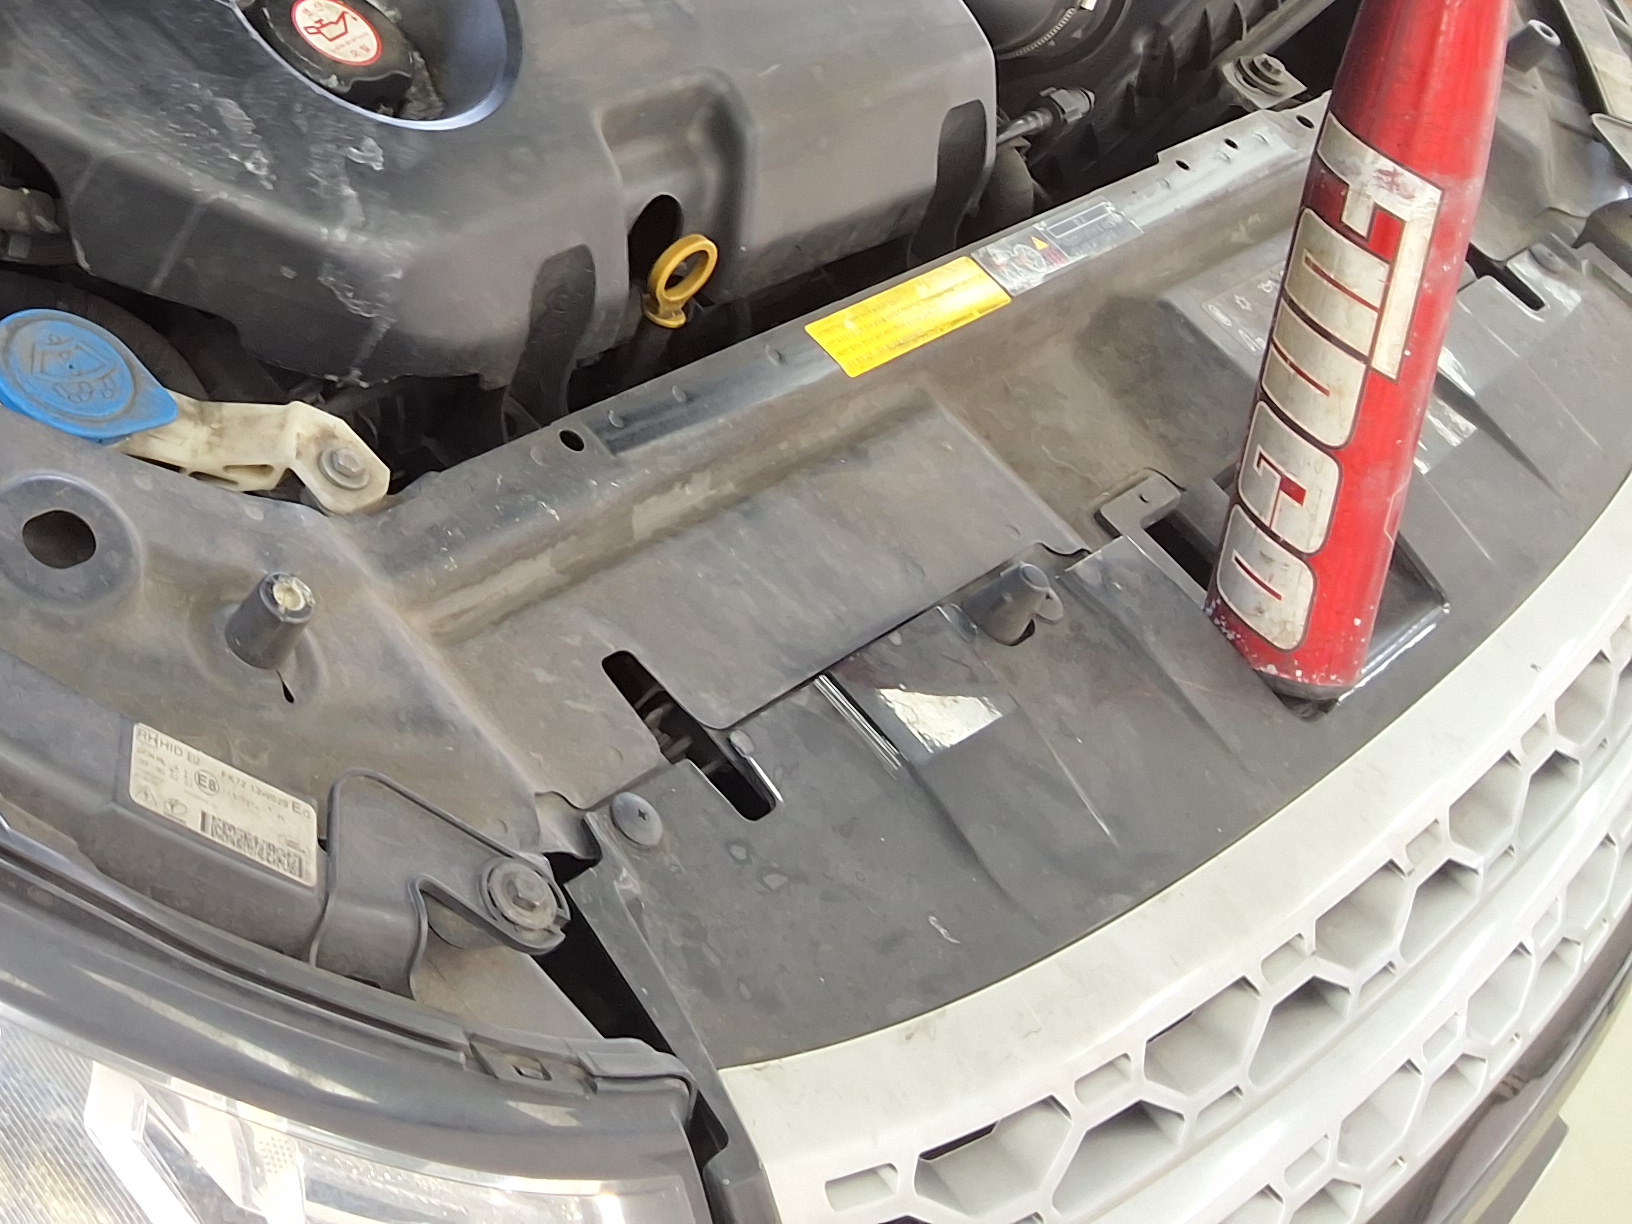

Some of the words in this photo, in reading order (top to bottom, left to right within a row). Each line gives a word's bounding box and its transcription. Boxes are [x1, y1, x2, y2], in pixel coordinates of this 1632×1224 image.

[137, 729, 158, 746] RH
[159, 739, 183, 757] HID
[186, 751, 200, 765] EU
[197, 772, 217, 792] E8
